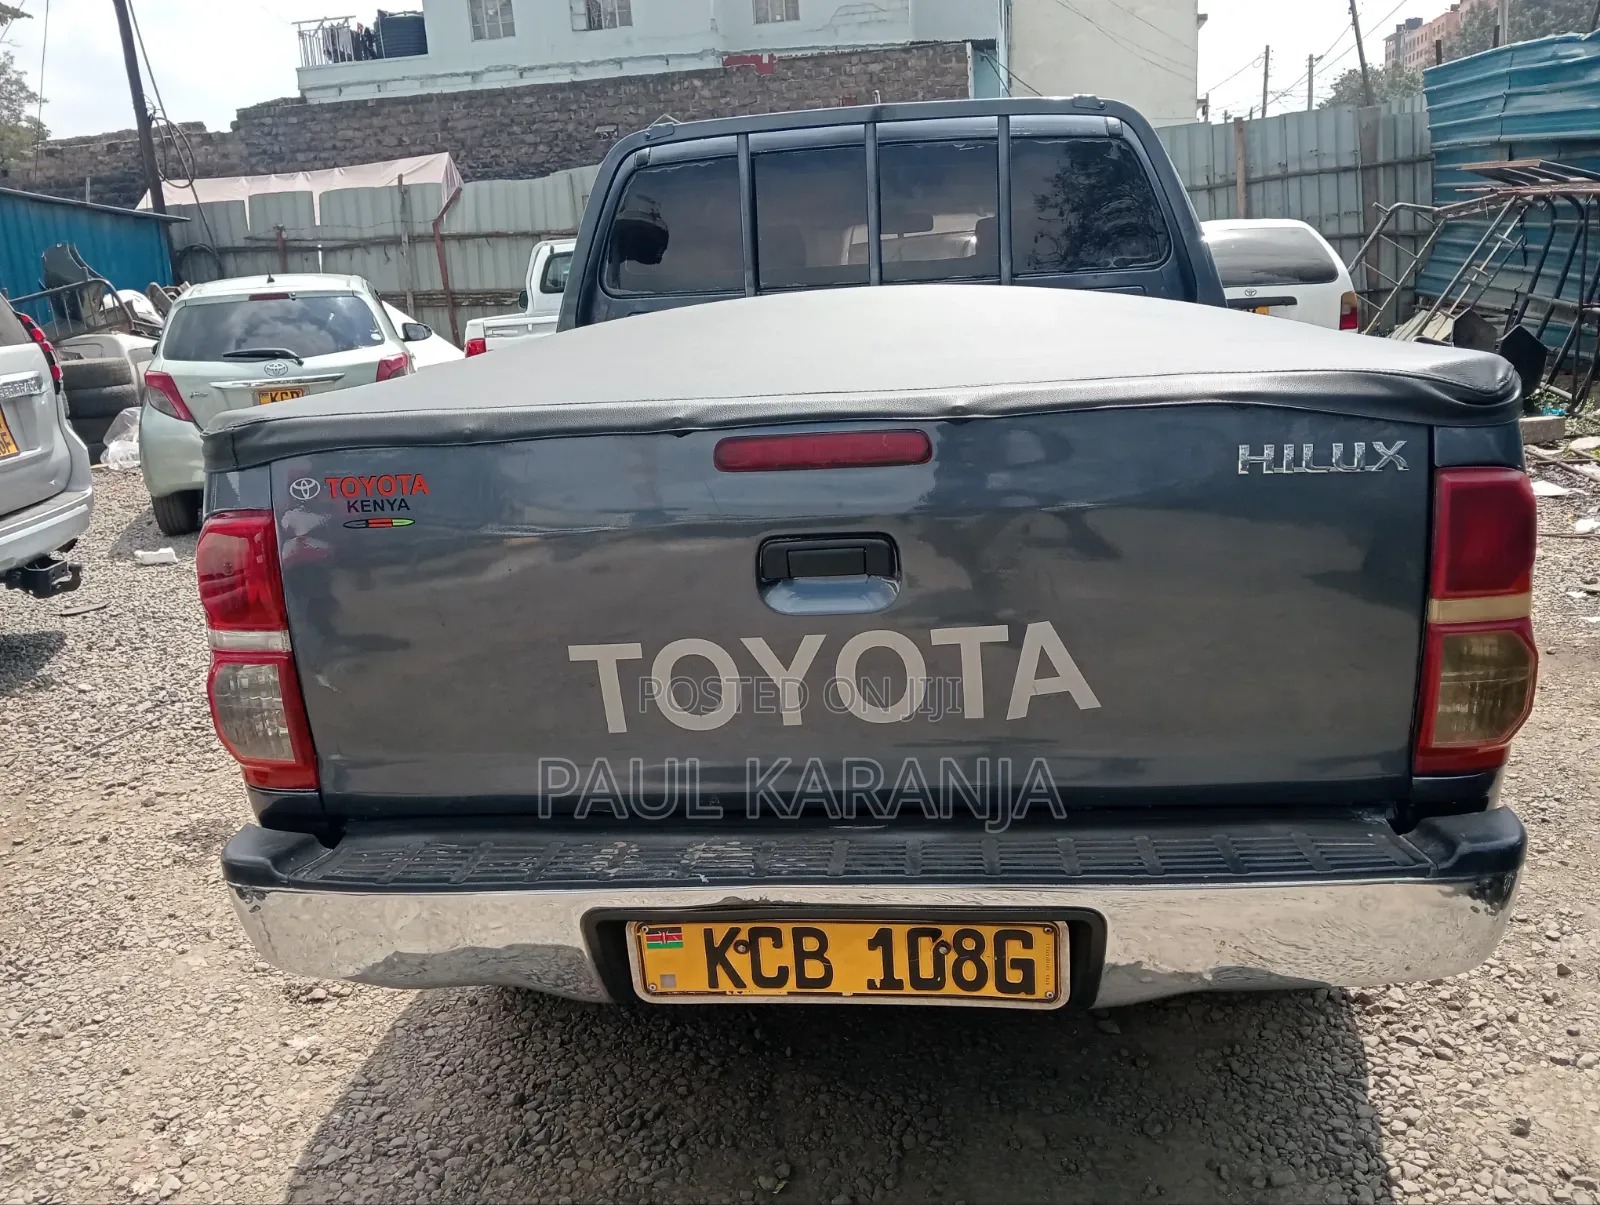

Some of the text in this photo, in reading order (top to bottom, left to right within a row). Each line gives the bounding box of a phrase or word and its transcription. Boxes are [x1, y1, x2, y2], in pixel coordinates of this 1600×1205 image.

[1237, 440, 1410, 475] HILUX
[324, 473, 431, 499] TOYOTA
[347, 498, 411, 513] KENYA
[568, 620, 1102, 734] TOYOTA
[703, 926, 834, 989] KCB
[866, 926, 1037, 995] 108G
